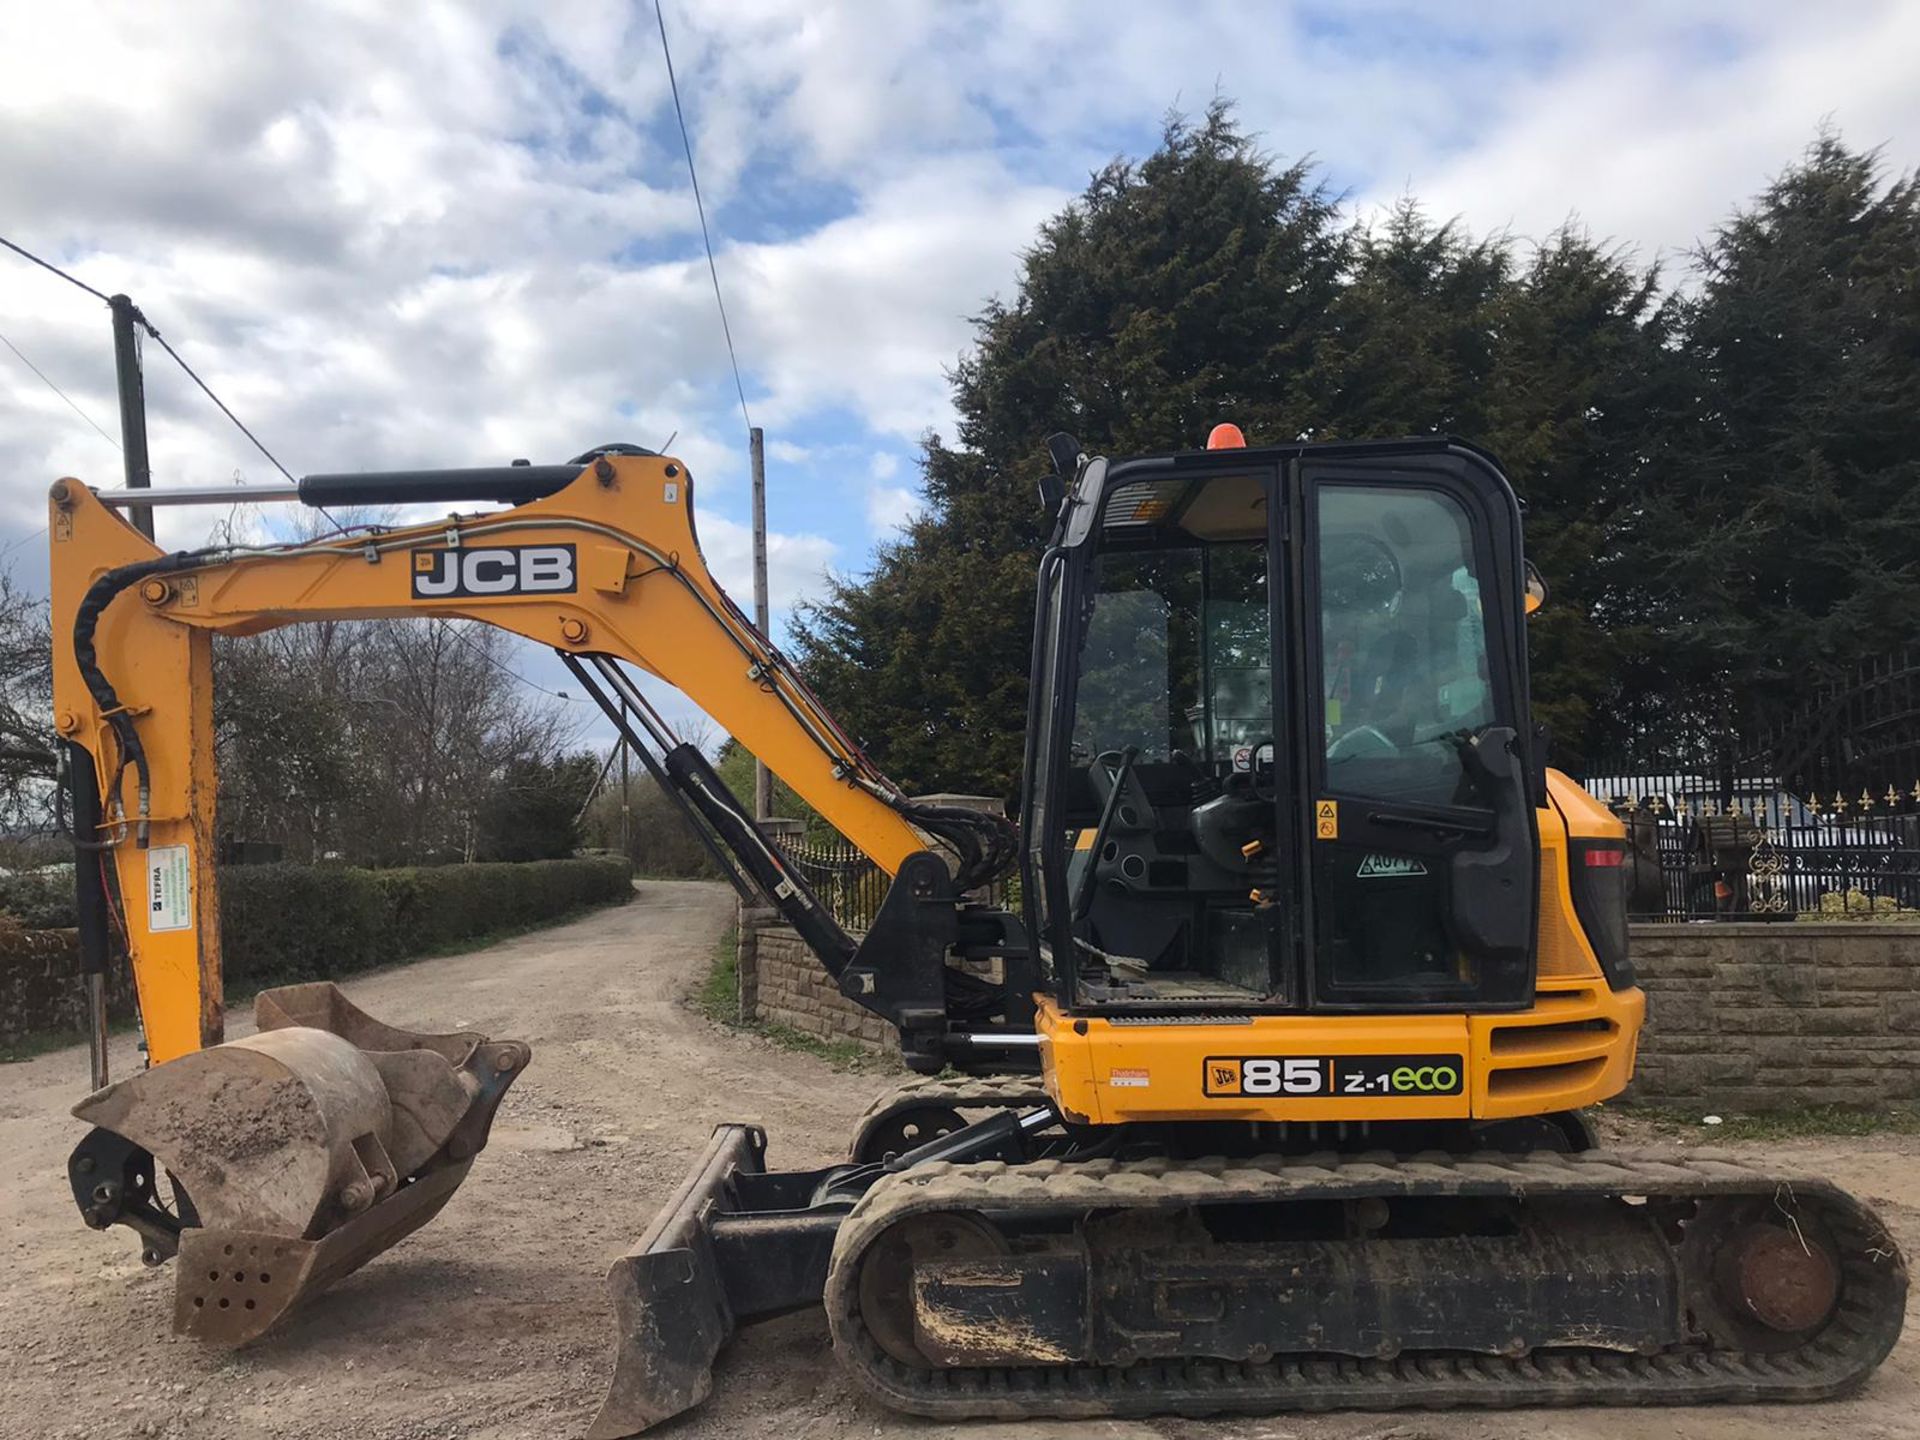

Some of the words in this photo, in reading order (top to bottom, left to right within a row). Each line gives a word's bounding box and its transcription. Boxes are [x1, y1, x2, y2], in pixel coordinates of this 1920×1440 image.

[416, 548, 573, 595] JCB
[153, 867, 162, 900] TEFRA
[1215, 1069, 1236, 1085] JCB
[1243, 1059, 1322, 1093] 85
